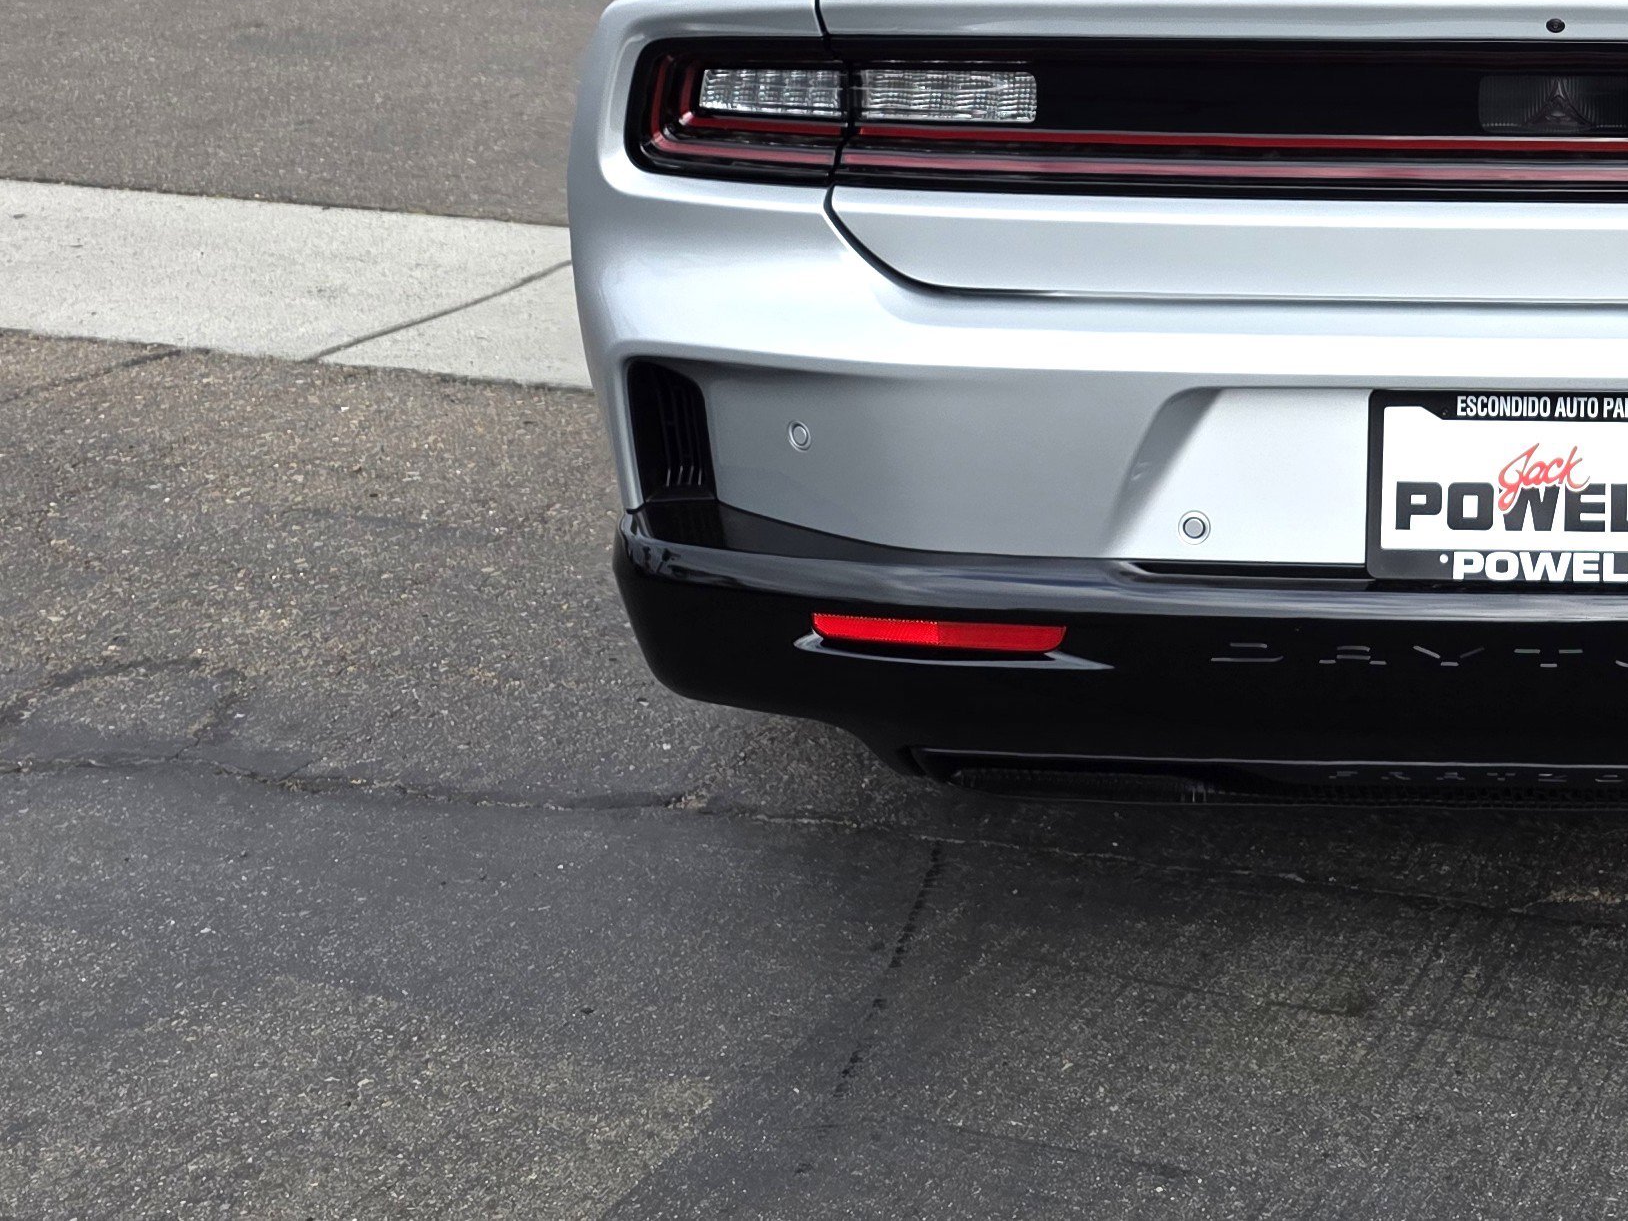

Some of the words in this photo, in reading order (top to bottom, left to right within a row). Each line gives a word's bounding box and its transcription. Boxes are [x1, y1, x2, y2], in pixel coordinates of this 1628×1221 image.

[1456, 395, 1552, 419] ESCONDIDO
[1554, 396, 1600, 419] AUTO
[1497, 442, 1591, 514] Jack
